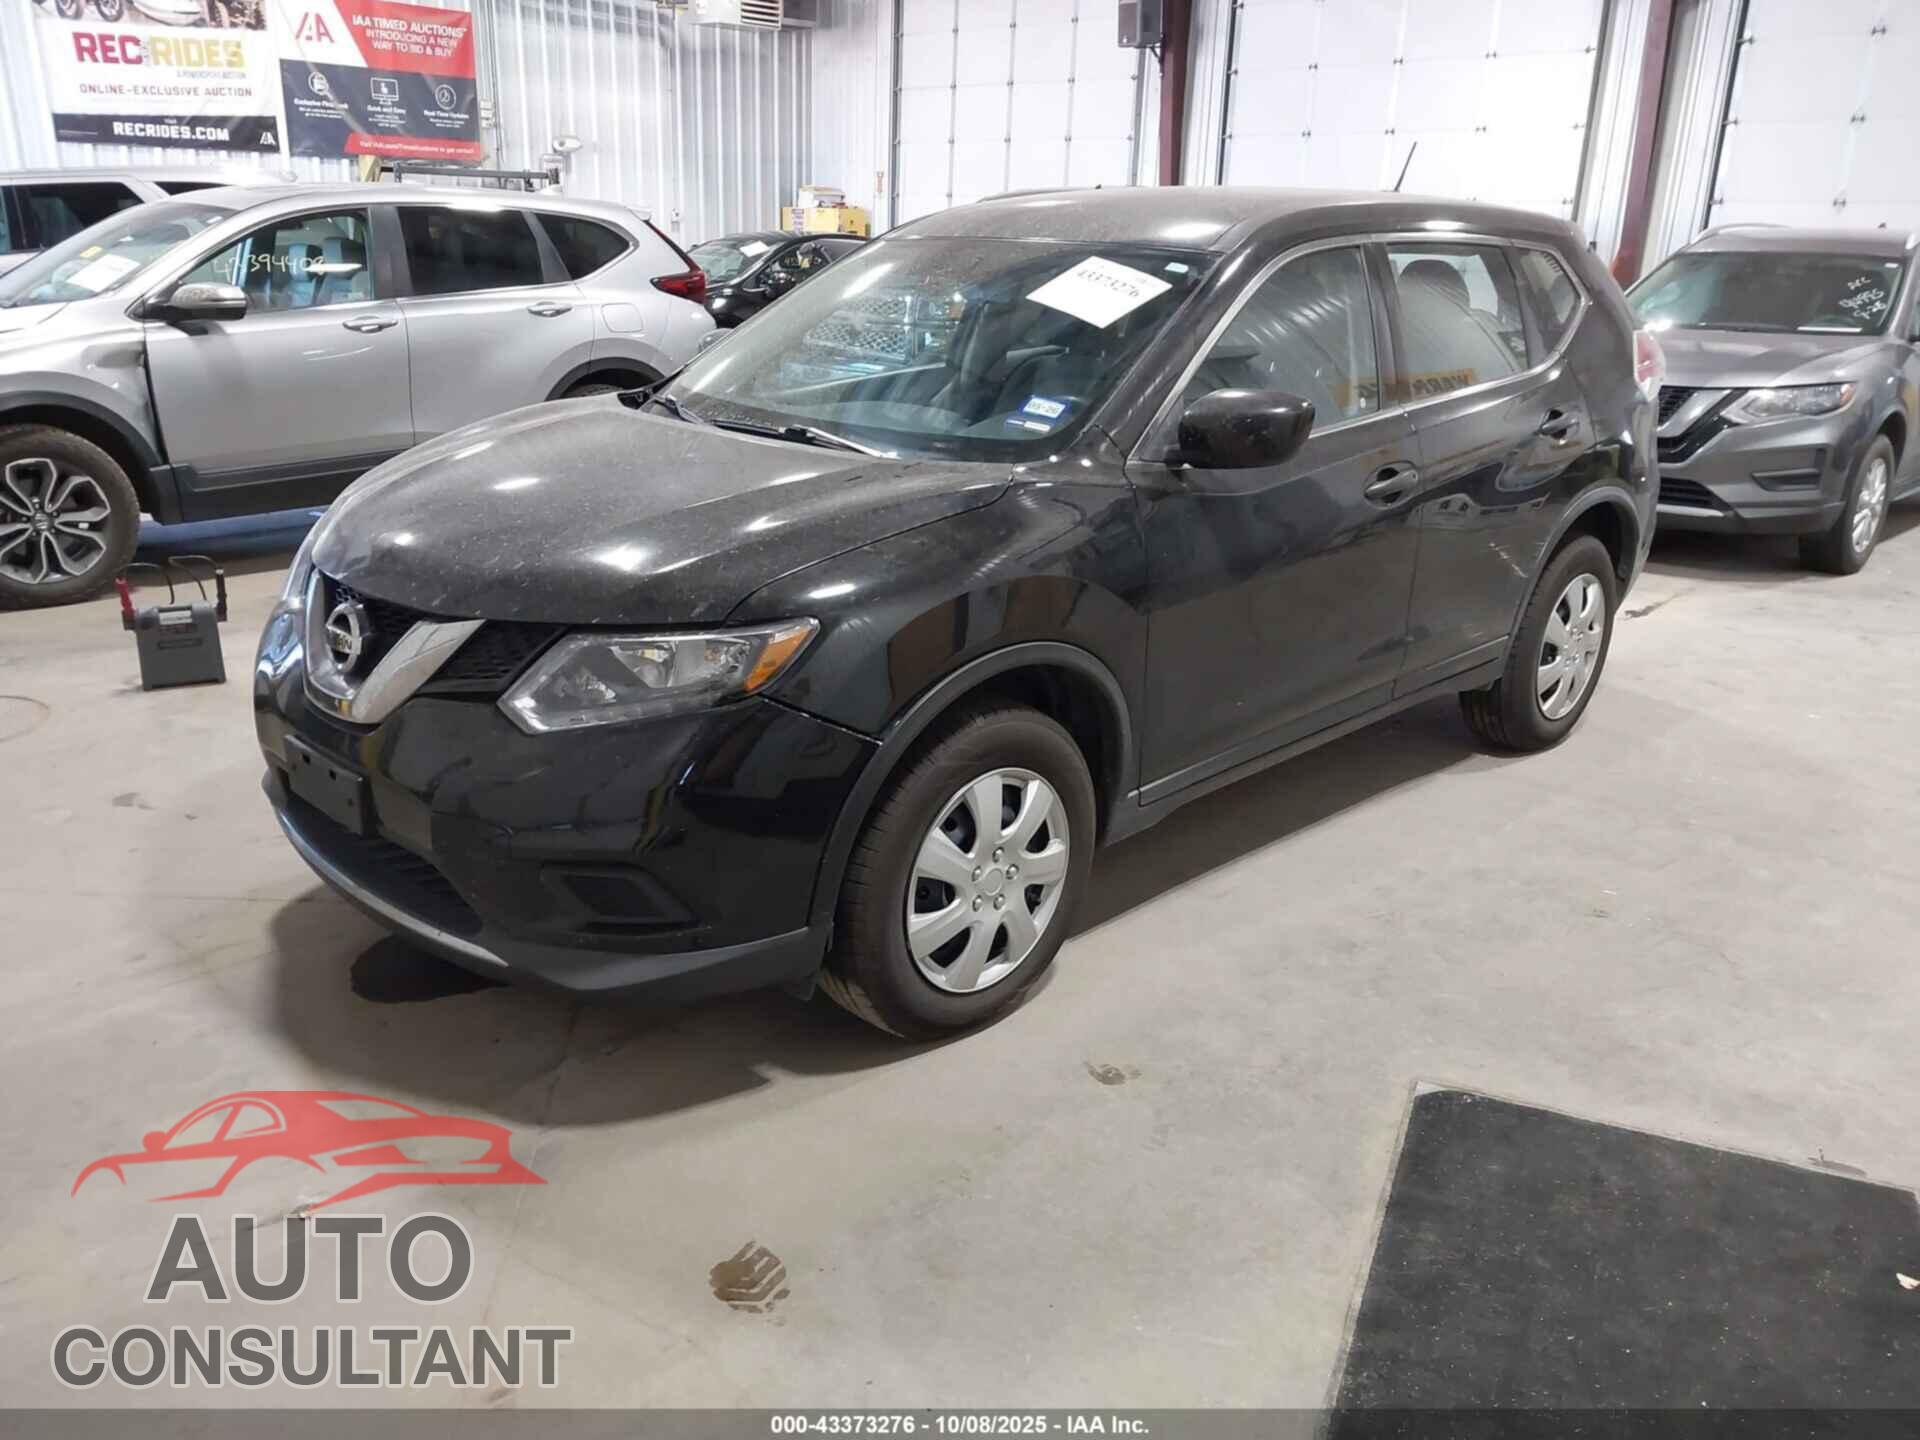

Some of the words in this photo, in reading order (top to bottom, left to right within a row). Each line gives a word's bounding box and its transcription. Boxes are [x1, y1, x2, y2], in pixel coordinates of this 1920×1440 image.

[72, 31, 143, 65] REC
[149, 34, 246, 69] RIDES
[395, 42, 409, 53] TO
[79, 84, 200, 97] ONLINE-EXCLUSIVE
[204, 85, 253, 97] AUCTION
[112, 122, 231, 141] RECRIDES.COM
